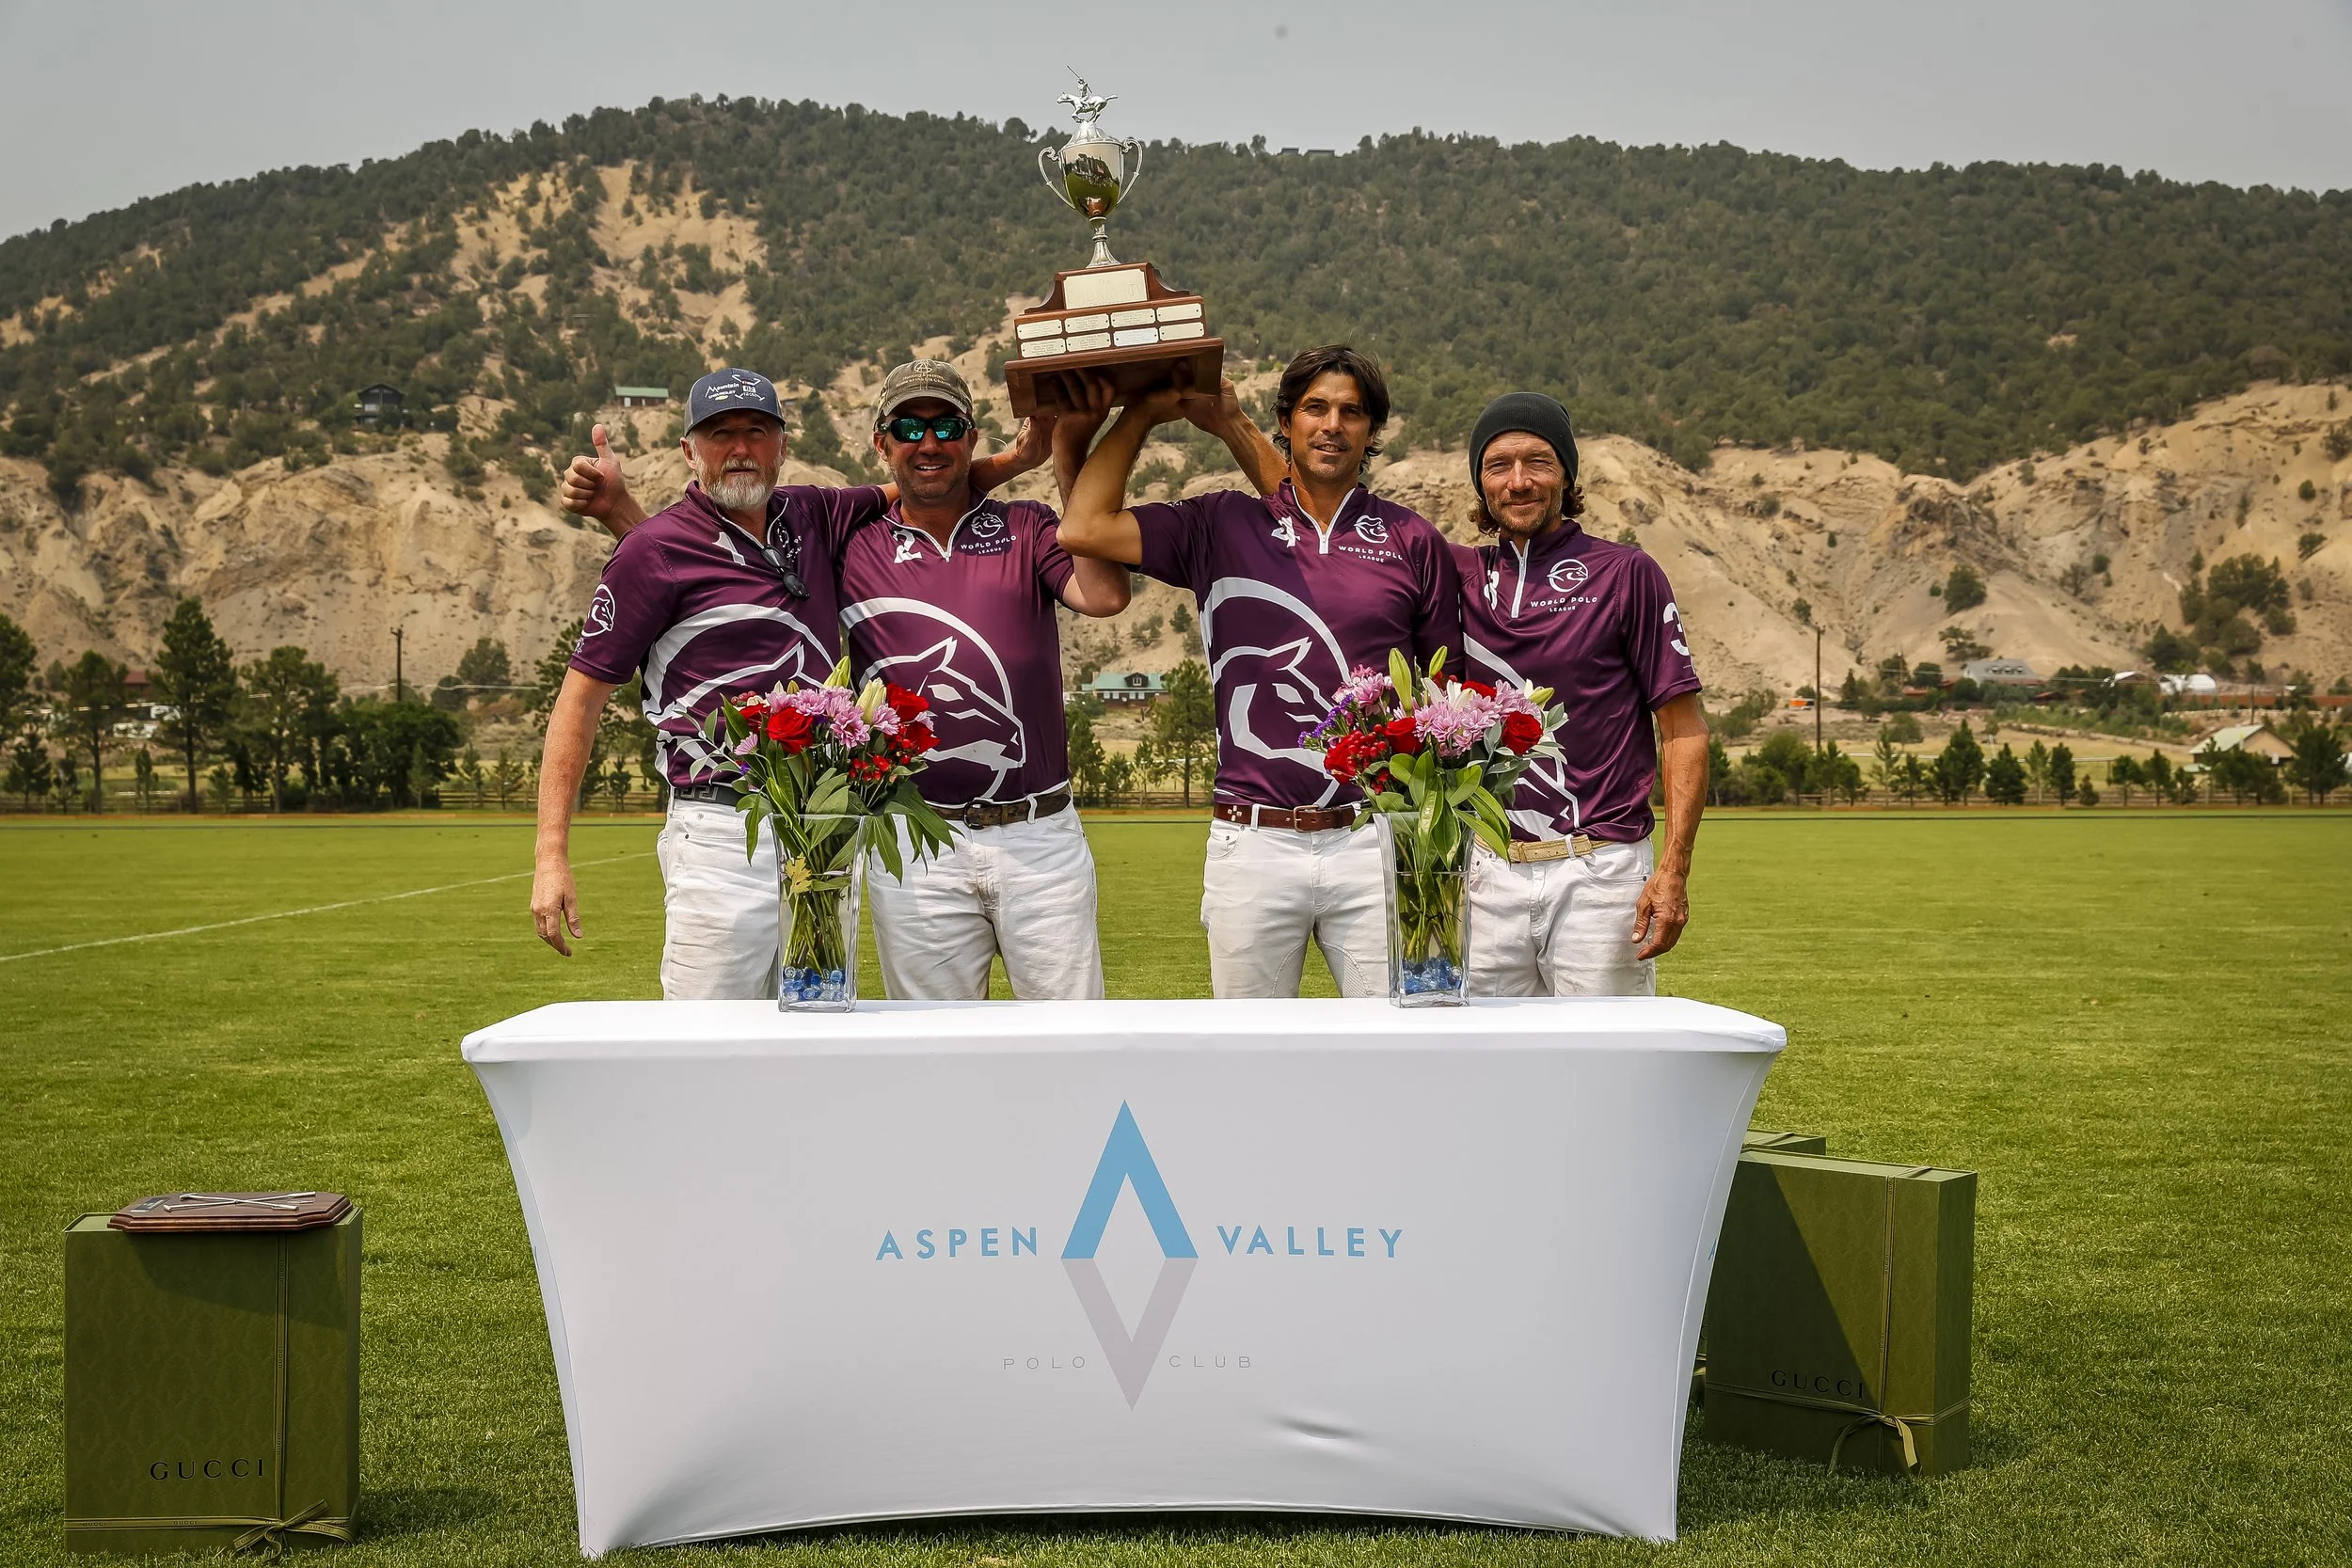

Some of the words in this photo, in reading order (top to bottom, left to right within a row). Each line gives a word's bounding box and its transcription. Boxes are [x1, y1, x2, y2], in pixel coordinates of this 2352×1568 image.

[961, 542, 991, 550] WORLD
[995, 535, 1017, 546] POLO
[1338, 545, 1374, 555] WORLD
[1359, 555, 1384, 563] LEAGUE
[1530, 597, 1565, 608] WORLD
[875, 1226, 1037, 1260] ASPEN
[1216, 1225, 1403, 1259] VALLEY
[1002, 1355, 1086, 1370] POLO
[1168, 1354, 1252, 1370] CLUB
[1771, 1370, 1865, 1399] GUCCI
[149, 1458, 263, 1481] GUCCI
[307, 1523, 331, 1533] GUCCI
